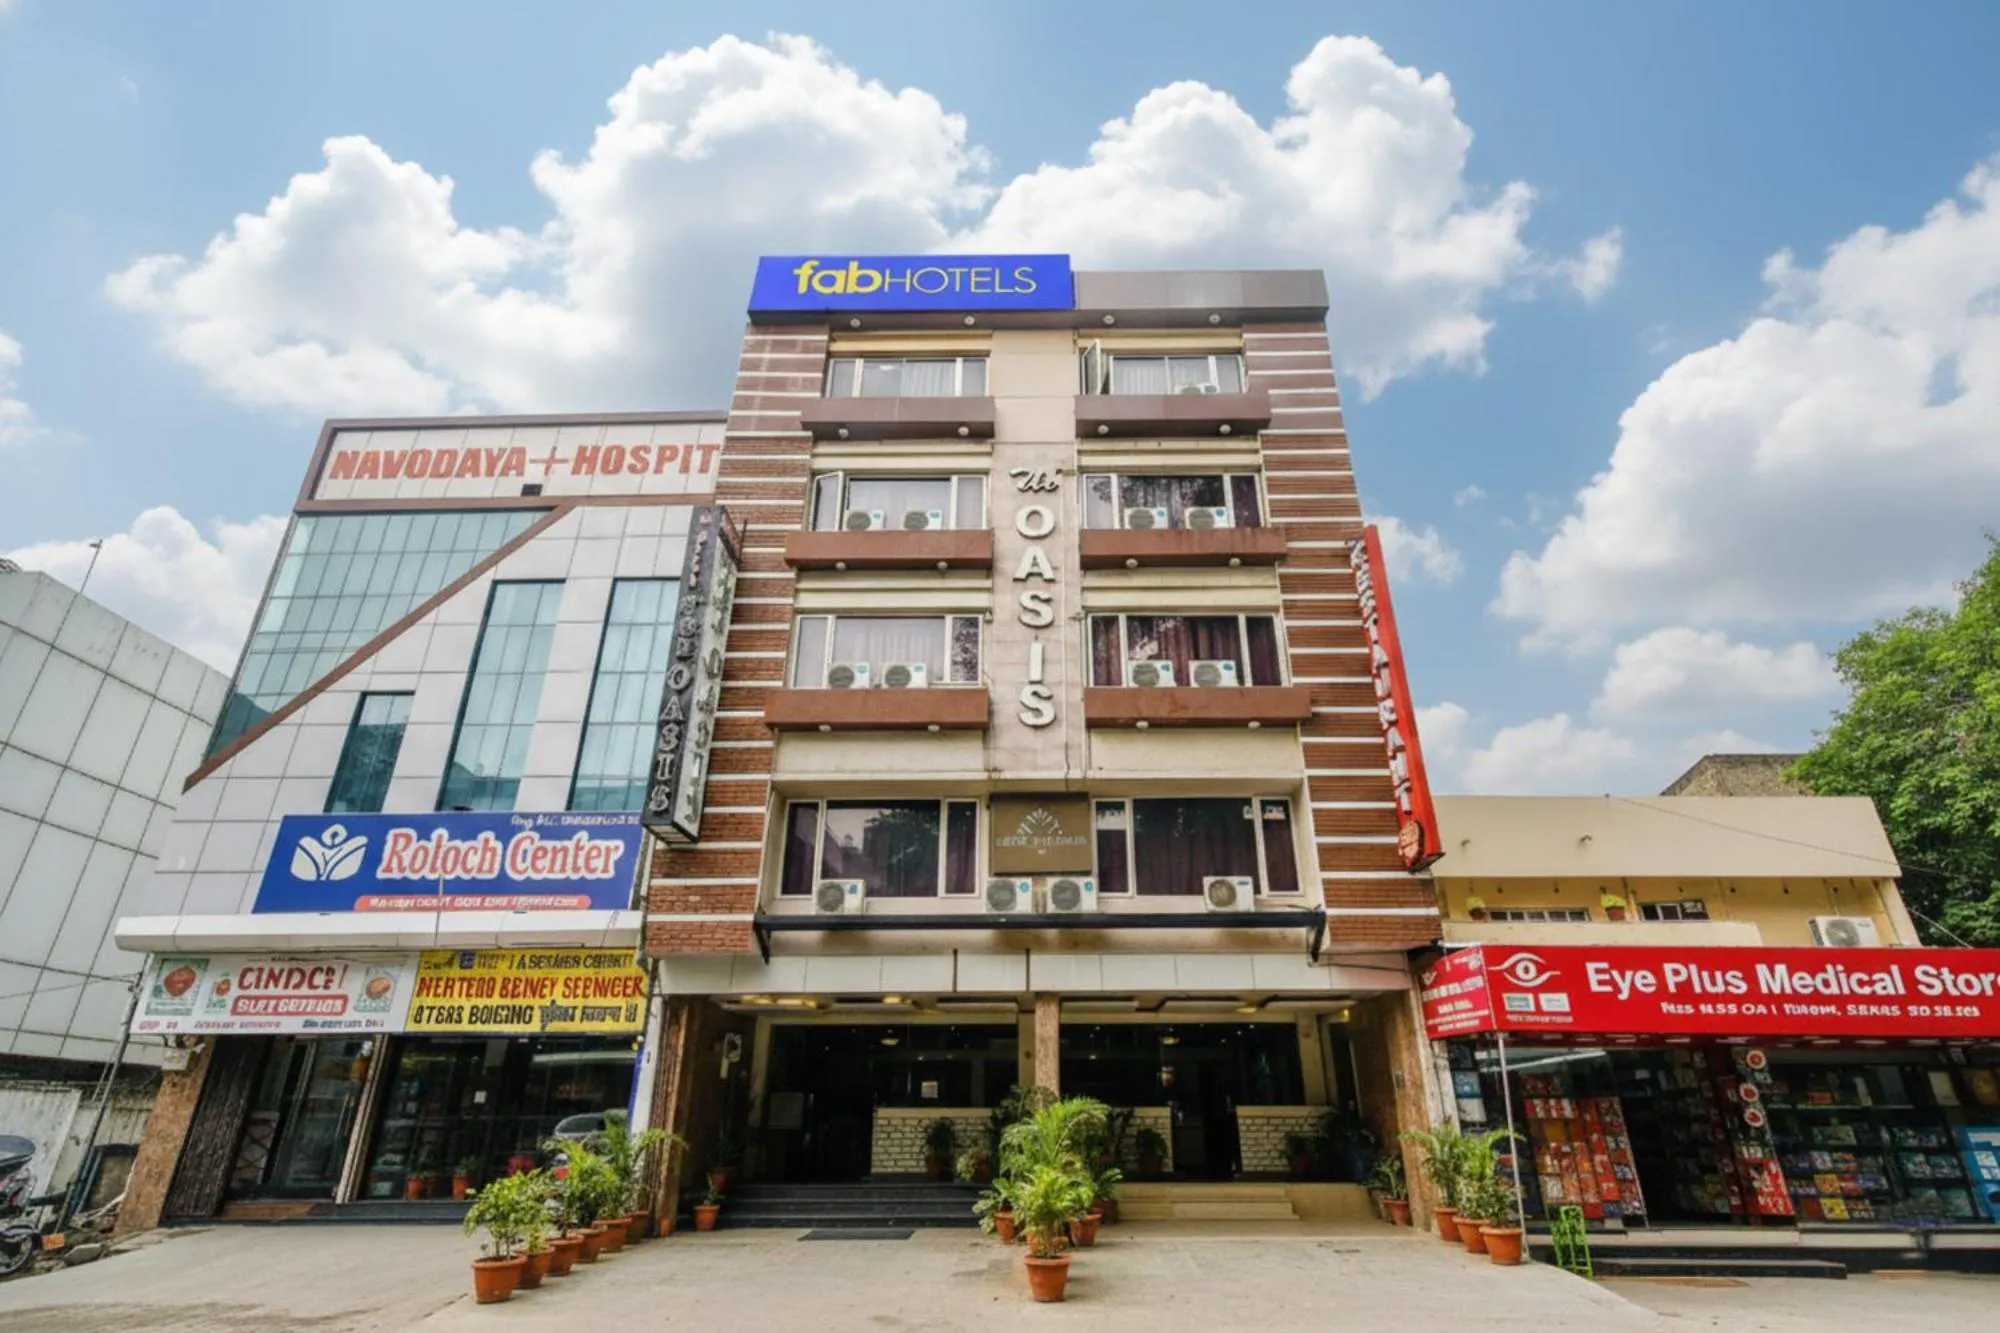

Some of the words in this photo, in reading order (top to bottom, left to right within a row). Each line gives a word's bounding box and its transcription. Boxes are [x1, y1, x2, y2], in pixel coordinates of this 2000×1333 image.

[329, 446, 527, 480] NAVODAYA
[570, 443, 721, 476] HOSPIT
[1013, 504, 1056, 728] OASIS
[377, 828, 502, 879] Roloch
[506, 830, 624, 880] Center
[1585, 961, 1657, 1000] Eye
[1662, 962, 1748, 994] Plus
[1754, 963, 1906, 995] Medical
[1914, 964, 2000, 997] Stor
